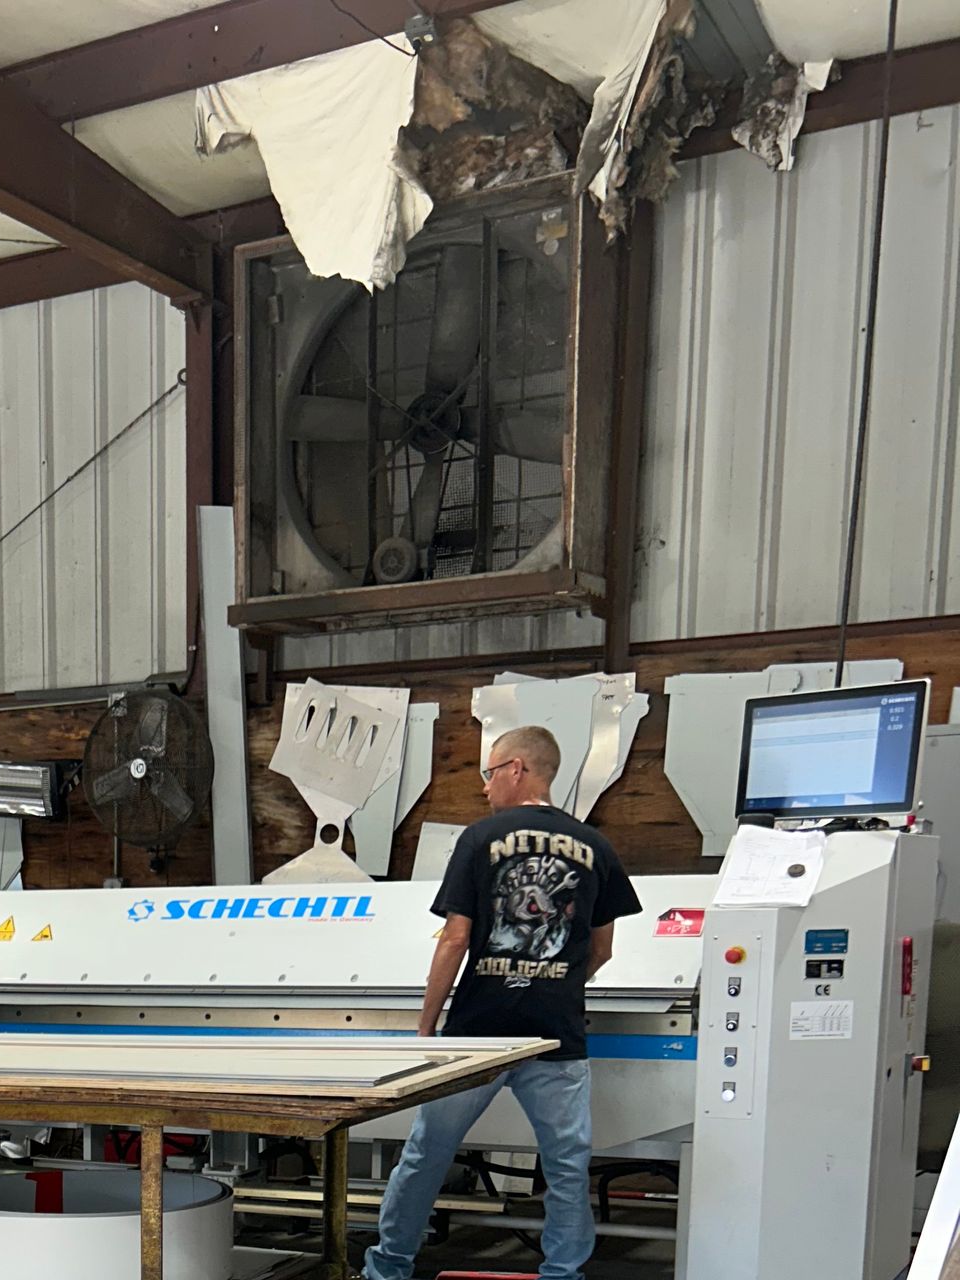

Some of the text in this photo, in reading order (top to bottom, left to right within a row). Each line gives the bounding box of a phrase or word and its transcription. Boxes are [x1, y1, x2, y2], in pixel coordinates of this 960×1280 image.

[489, 829, 595, 871] NITRO
[160, 896, 376, 920] SCHECHTL
[815, 984, 831, 996] CE
